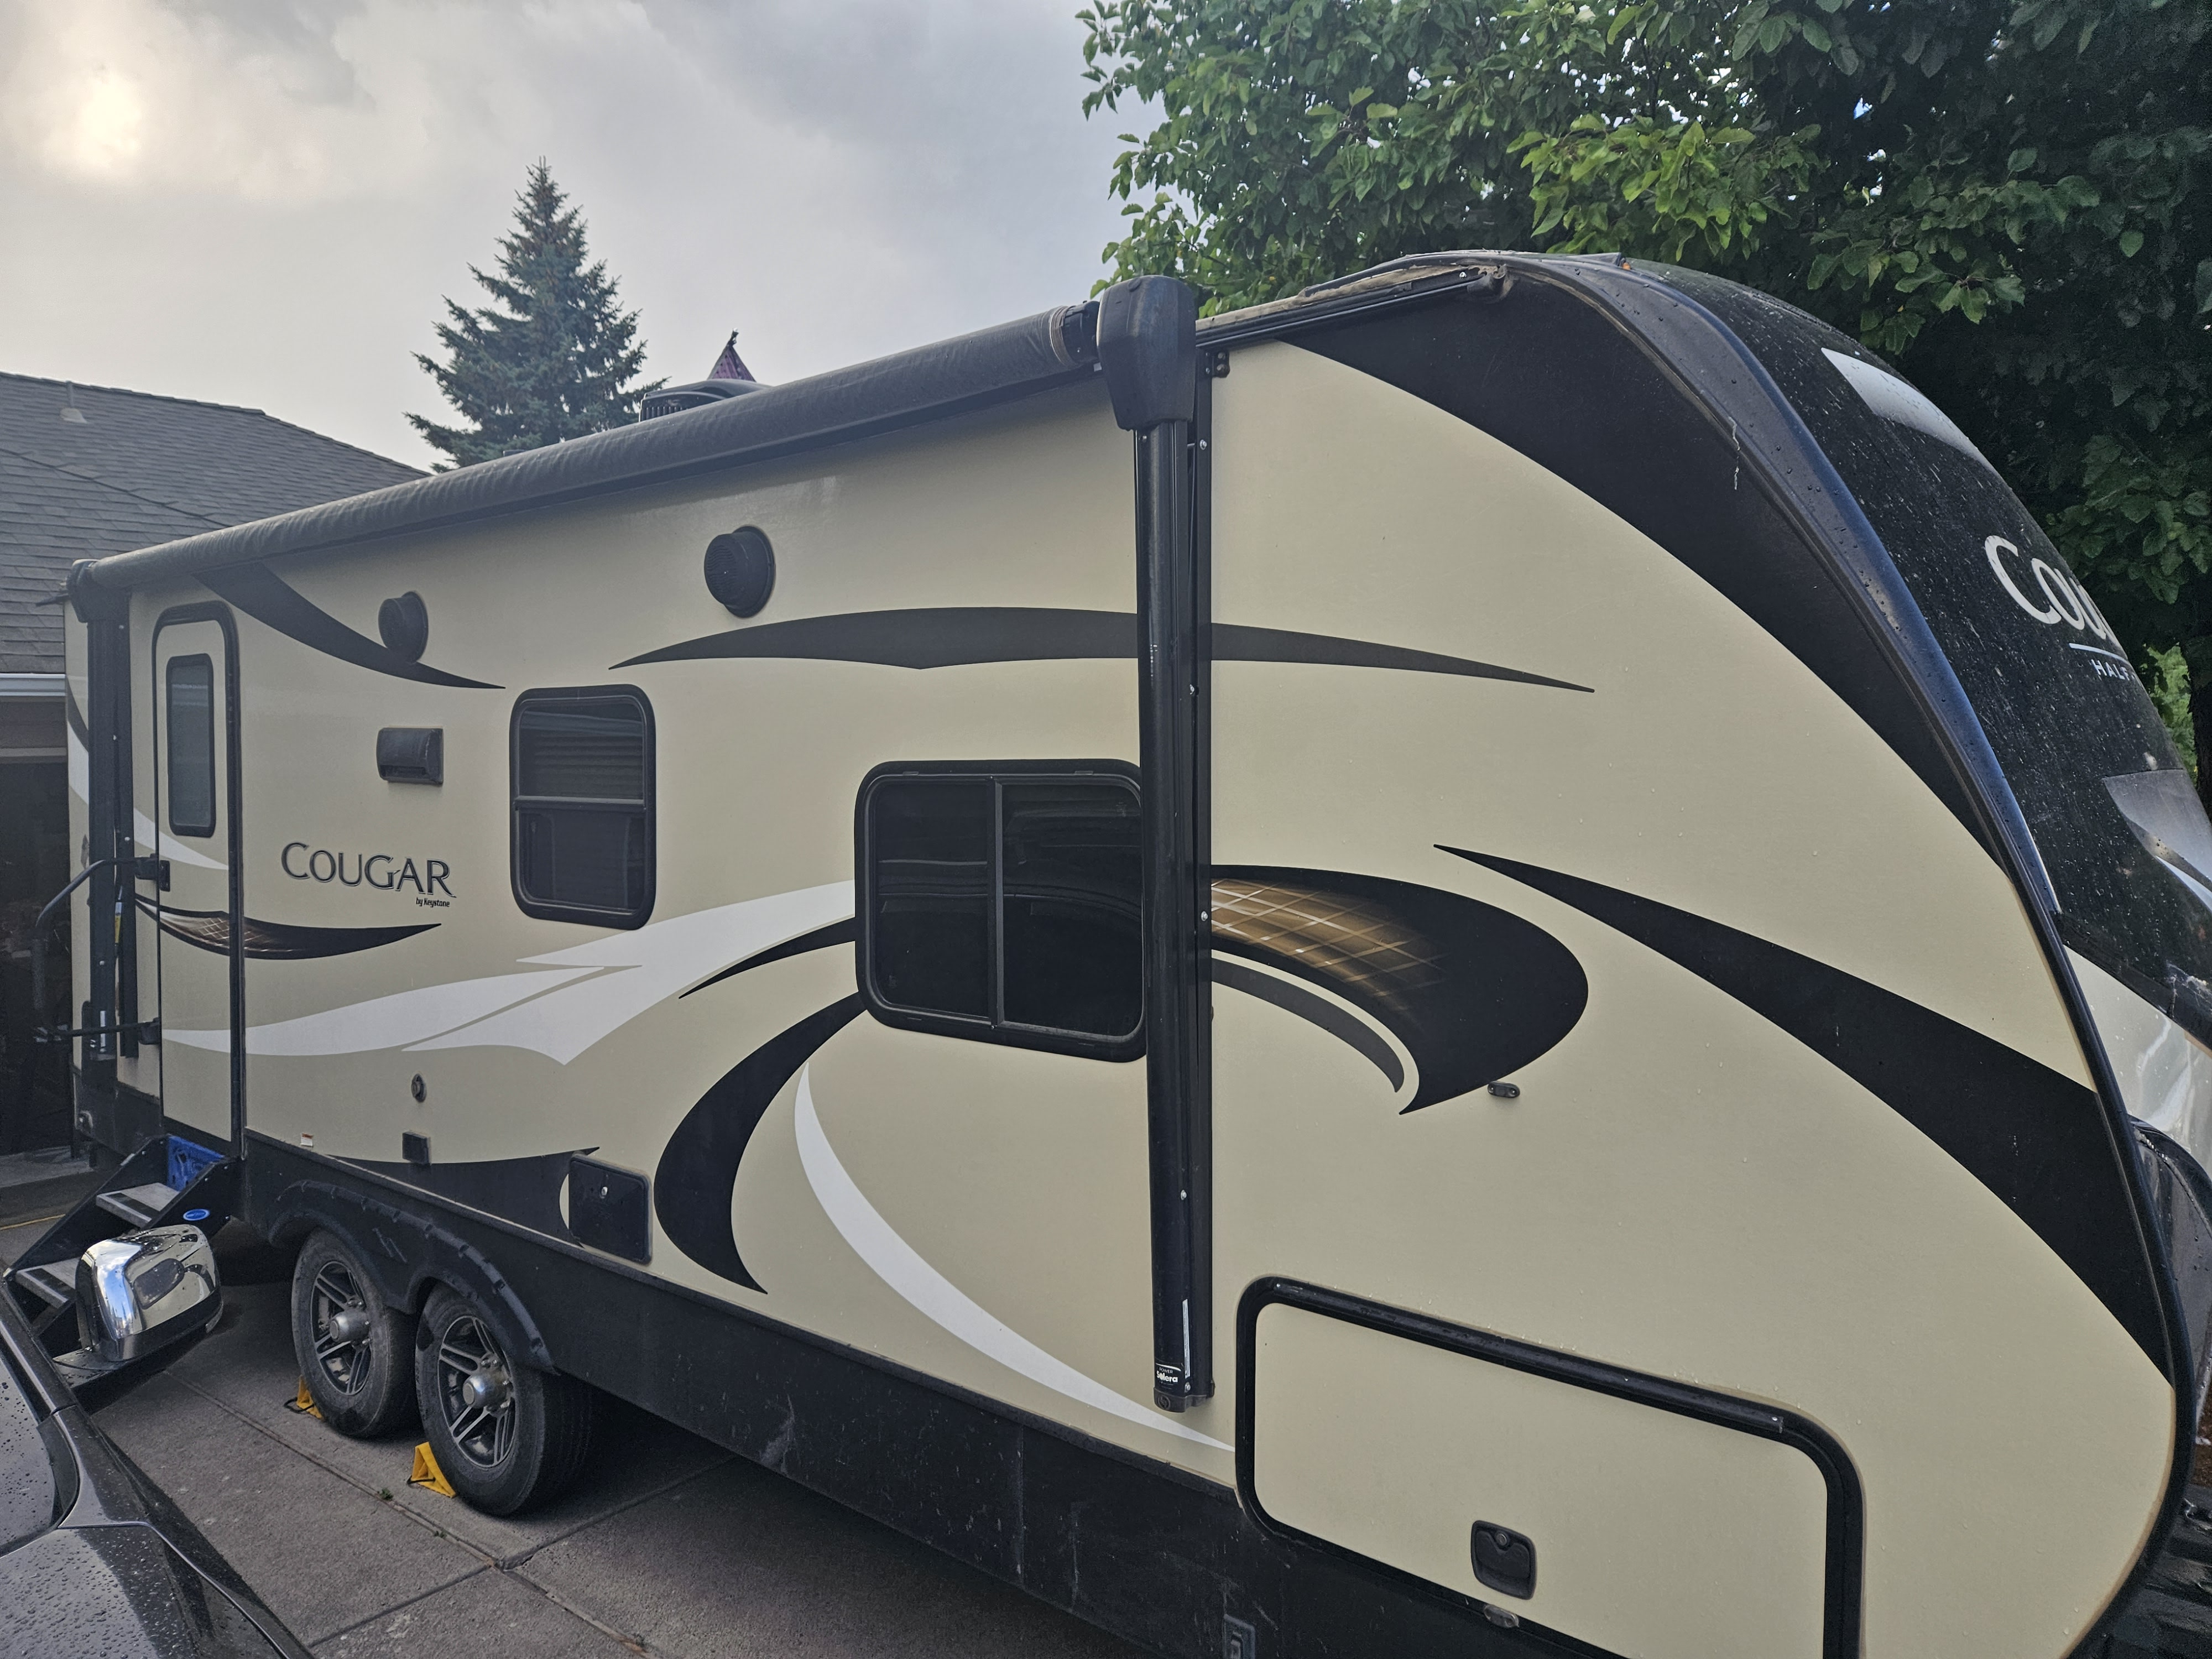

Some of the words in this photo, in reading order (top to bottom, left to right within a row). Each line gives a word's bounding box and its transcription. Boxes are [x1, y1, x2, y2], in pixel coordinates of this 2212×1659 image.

[1985, 535, 2121, 647] COU
[281, 842, 457, 898] COUGAR
[416, 897, 423, 907] by
[424, 898, 450, 908] Keystone
[1156, 1370, 1178, 1383] Solera
